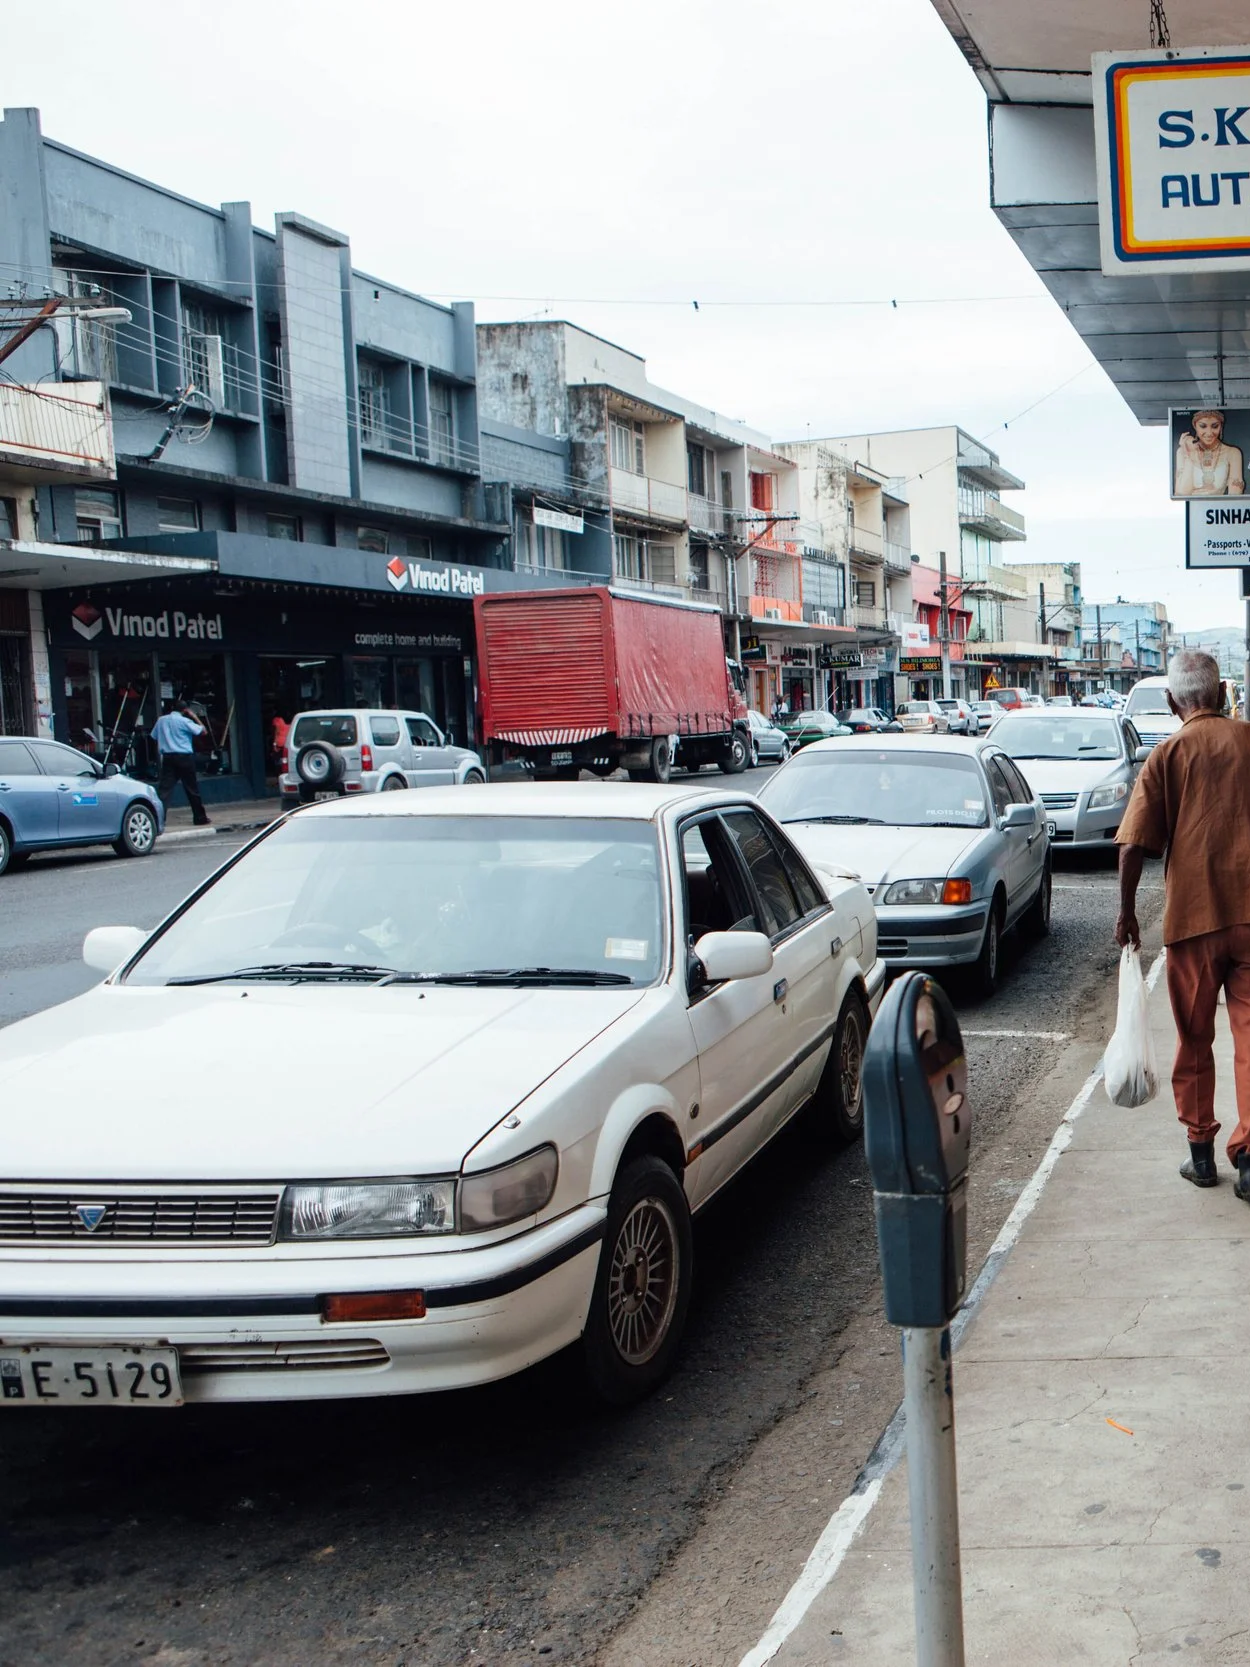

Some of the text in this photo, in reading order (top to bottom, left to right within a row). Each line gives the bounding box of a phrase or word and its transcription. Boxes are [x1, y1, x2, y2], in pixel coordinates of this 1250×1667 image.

[409, 563, 484, 595] Vinod Patel
[106, 607, 223, 640] Vinod Patel
[354, 632, 462, 651] complete home and building
[832, 654, 861, 665] KUMAR
